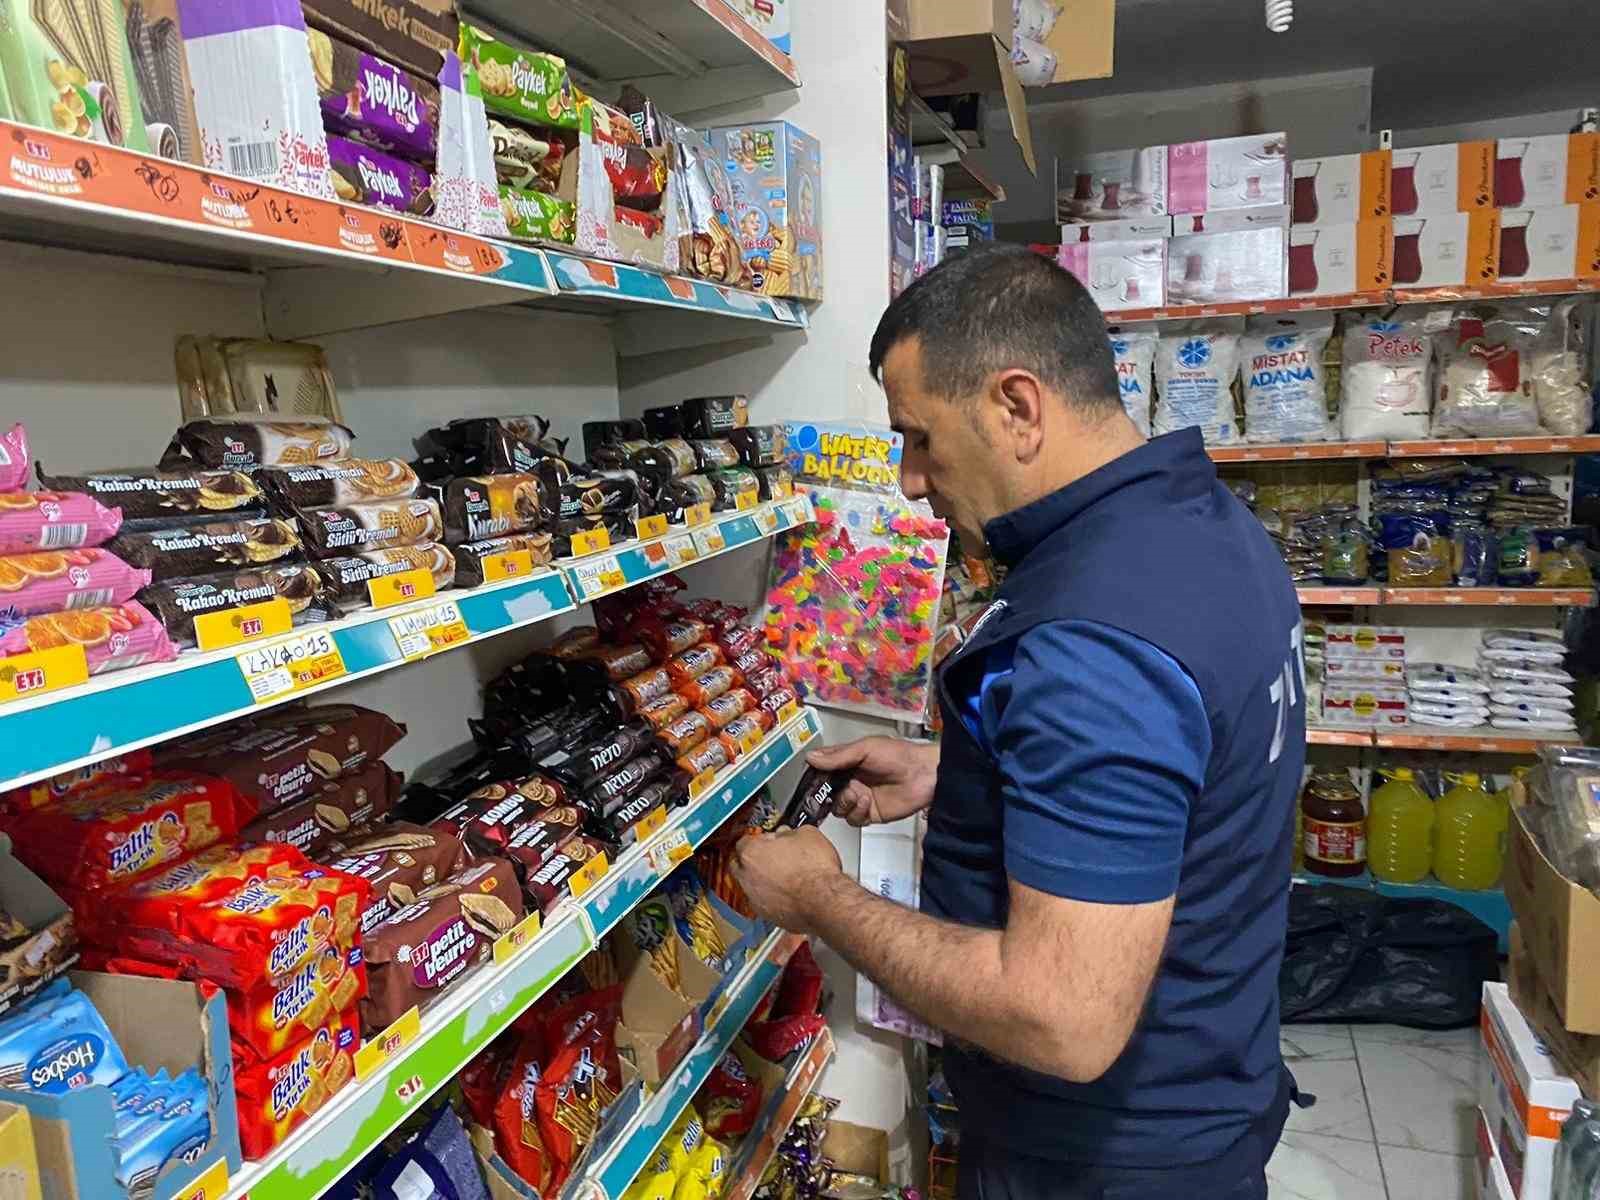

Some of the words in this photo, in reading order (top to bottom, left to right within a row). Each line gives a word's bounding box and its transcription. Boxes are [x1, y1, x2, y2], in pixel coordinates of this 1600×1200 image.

[511, 60, 547, 97] Paykek
[358, 161, 404, 201] Paykek
[1367, 333, 1425, 358] Petek
[1250, 366, 1316, 389] ADANA
[820, 432, 890, 464] WATER
[87, 478, 142, 493] Kakao
[138, 476, 201, 492] Kremalı
[151, 535, 202, 552] Kakao
[175, 594, 226, 613] Kakao
[221, 584, 277, 605] Kremalı
[440, 605, 457, 622] 15
[306, 635, 330, 655] 15
[590, 743, 622, 771] nero
[602, 770, 633, 796] nero
[479, 793, 526, 827] KOMBO
[616, 796, 650, 823] nero
[507, 821, 547, 849] KOMBO
[528, 854, 572, 886] KOMBO
[430, 919, 467, 957] petit
[423, 932, 476, 981] beurre
[272, 961, 317, 1020] Balık
[30, 1041, 96, 1088] Hosbes
[271, 1047, 311, 1111] Balık
